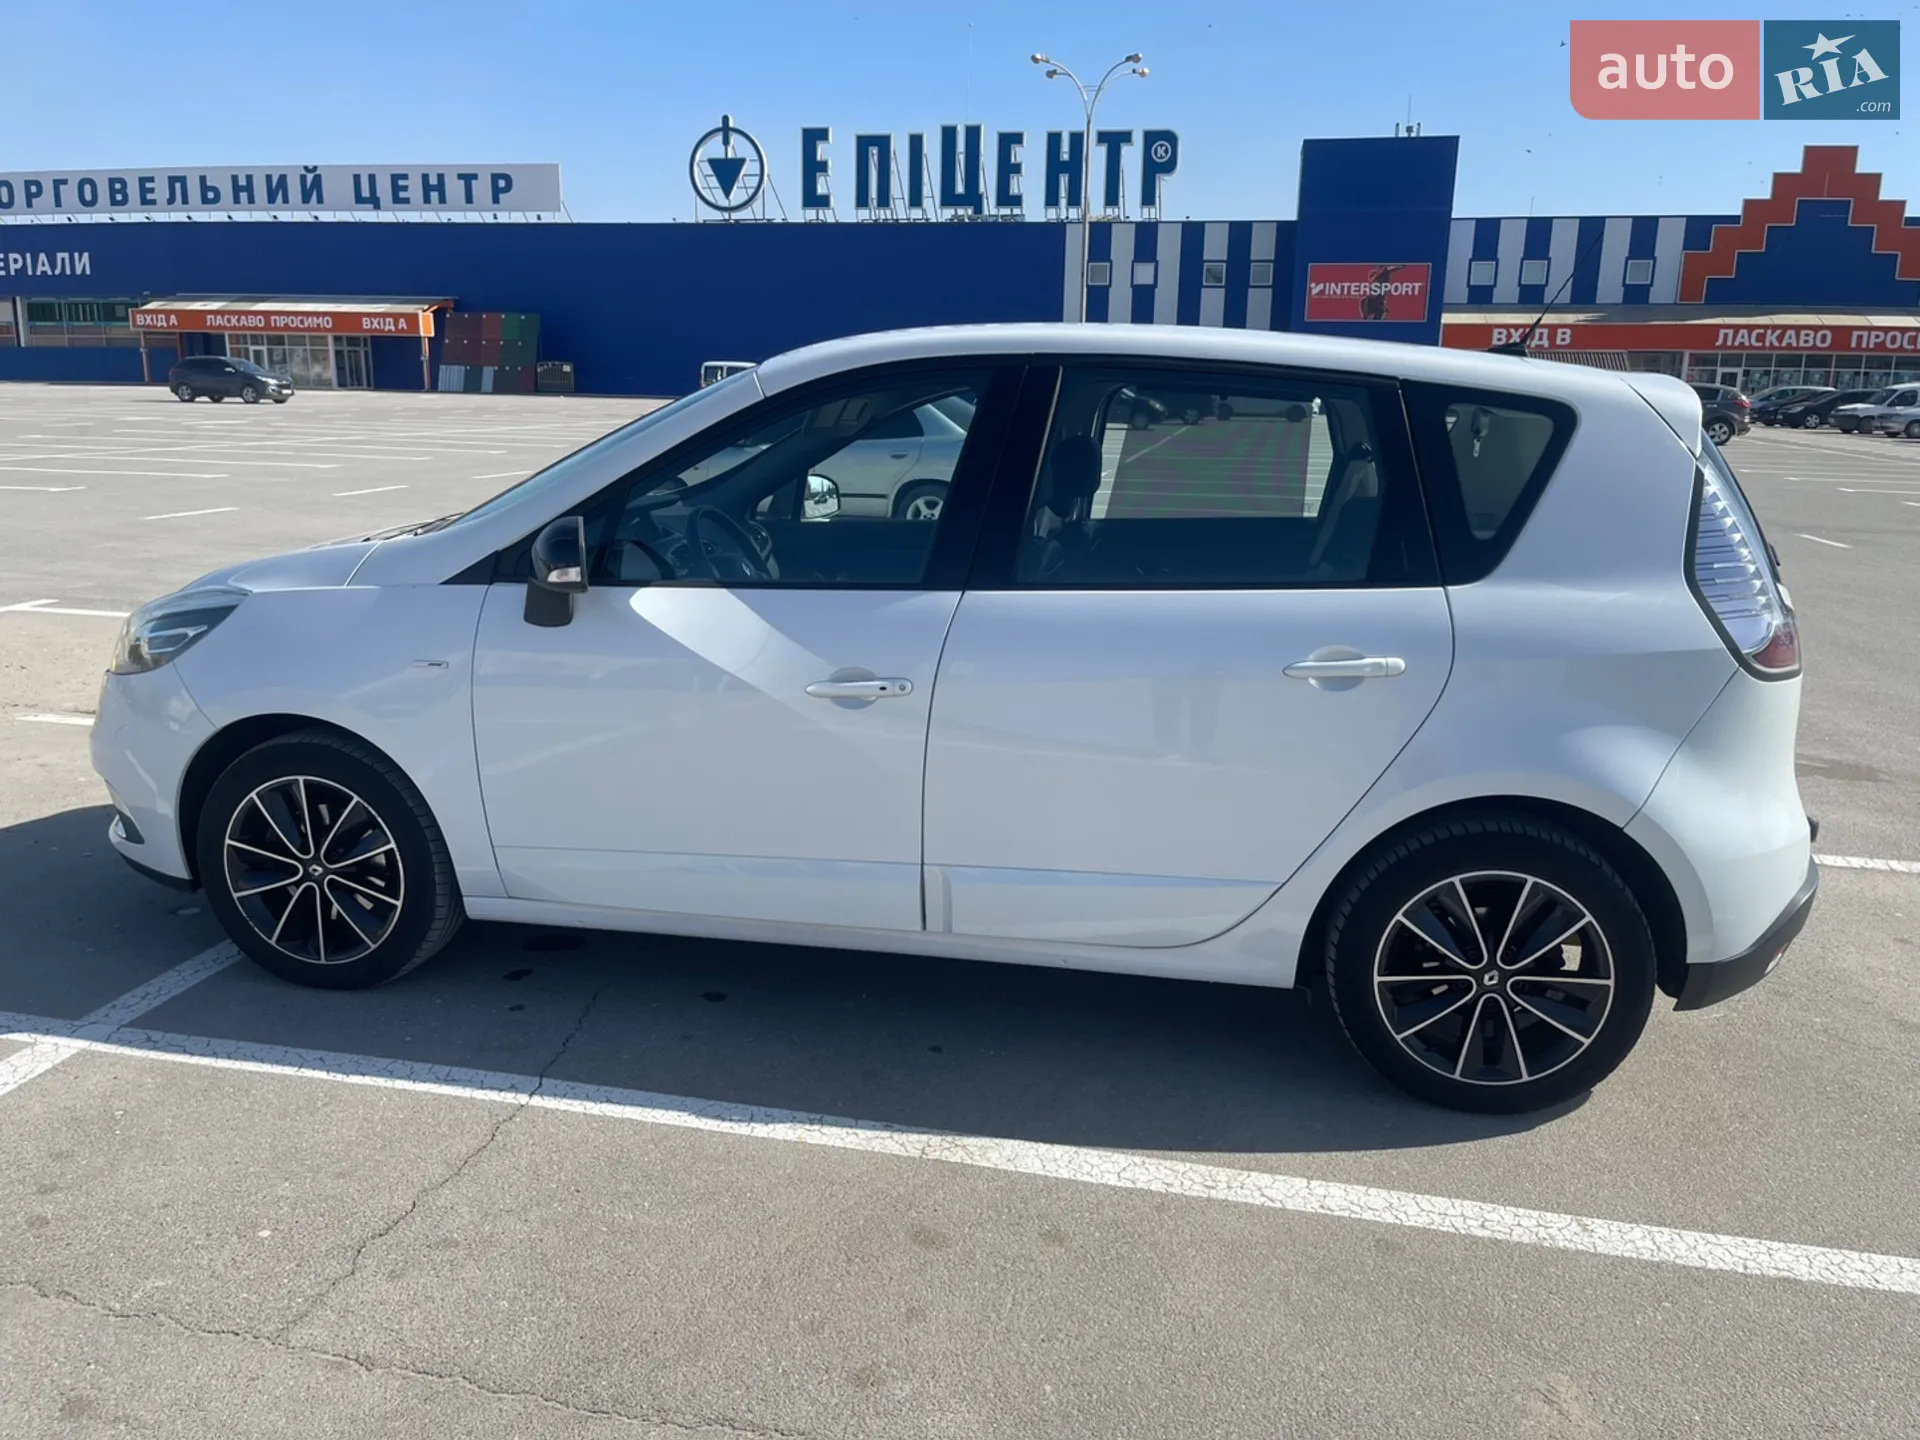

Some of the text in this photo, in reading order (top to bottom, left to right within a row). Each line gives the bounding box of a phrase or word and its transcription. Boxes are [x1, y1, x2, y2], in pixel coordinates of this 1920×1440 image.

[801, 124, 1179, 214] ЕПІЦЕНТР
[0, 165, 514, 211] ОРГОВЕЛЬНИЙ ЦЕНТР
[1324, 282, 1422, 296] INTERSPORT
[136, 313, 178, 328] ВХІД А
[206, 314, 333, 329] ЛАСКАВО ПРОСИМО
[362, 317, 407, 332] ВХІД А
[1492, 328, 1549, 348] ВХД
[1715, 328, 1920, 350] ЛАСКАВО ПРОС
